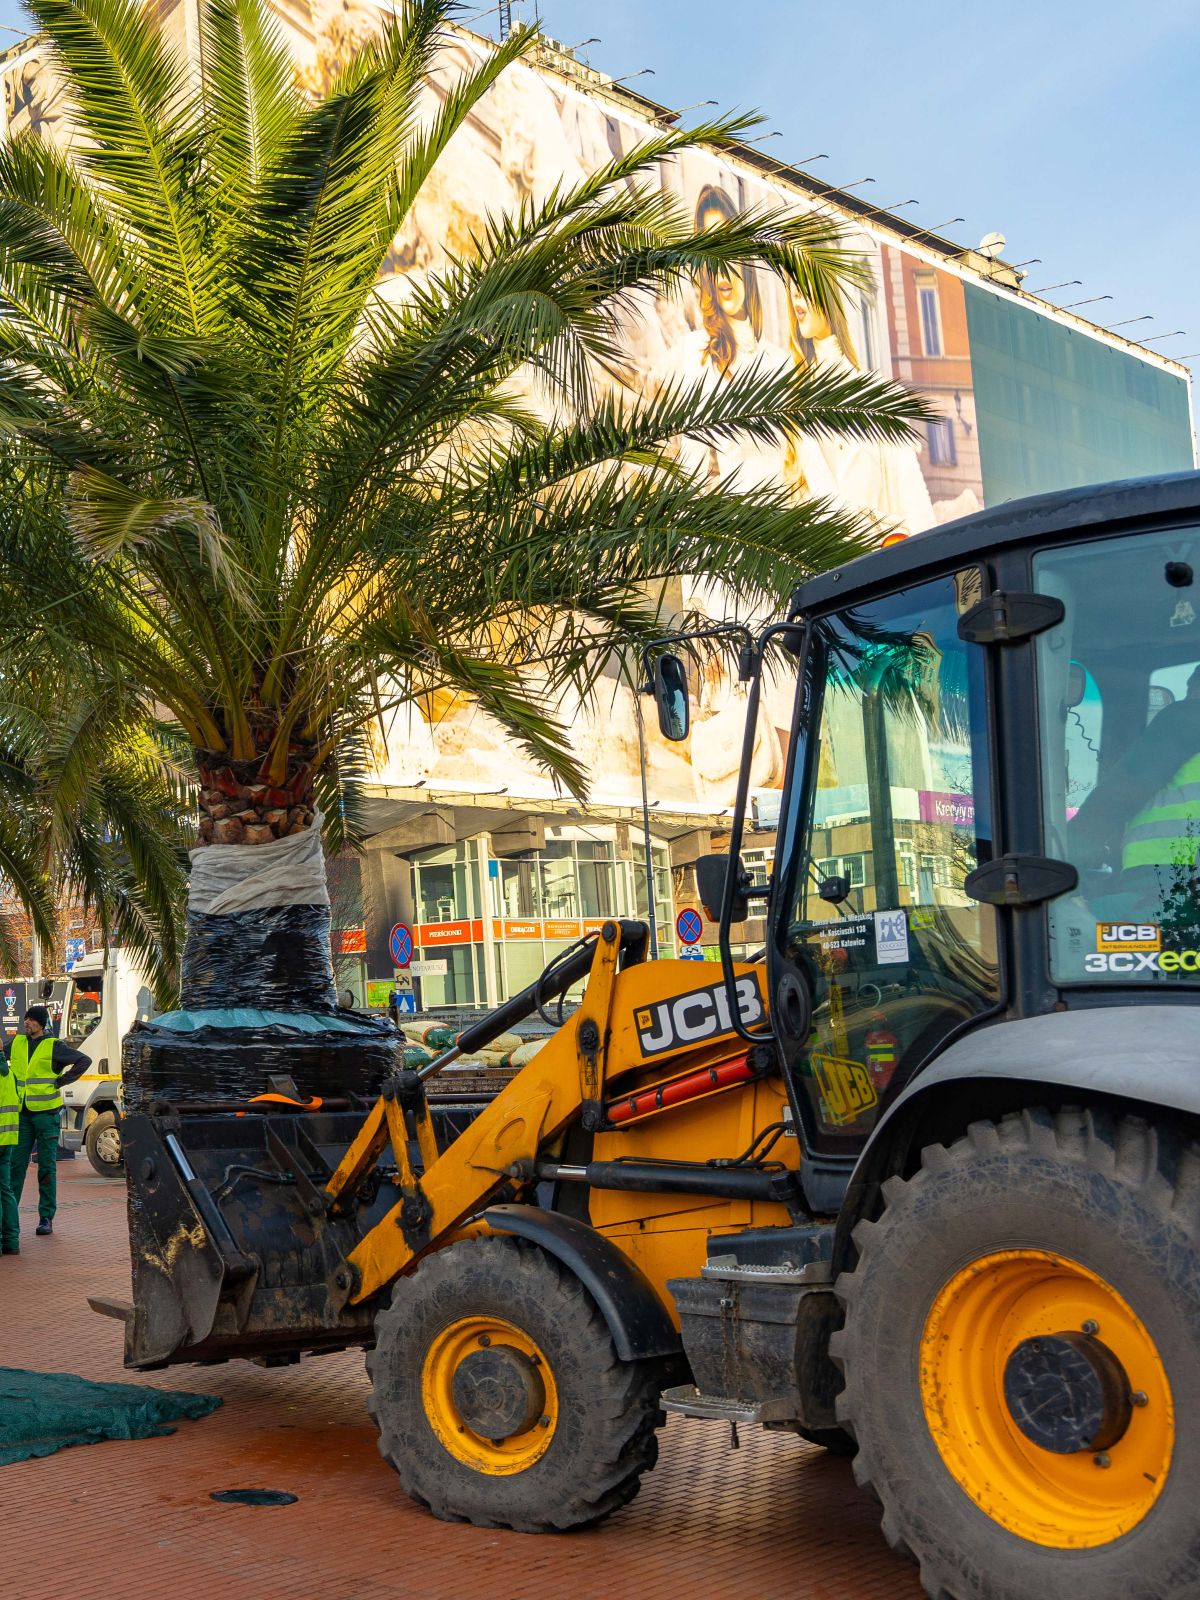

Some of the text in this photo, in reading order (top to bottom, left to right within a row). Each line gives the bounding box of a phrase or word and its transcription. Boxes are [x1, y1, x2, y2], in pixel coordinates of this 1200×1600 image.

[856, 925, 866, 934] 138
[1103, 925, 1157, 941] JCB
[841, 938, 866, 949] Katowice
[641, 979, 761, 1051] JCB
[822, 1060, 874, 1115] JCB
